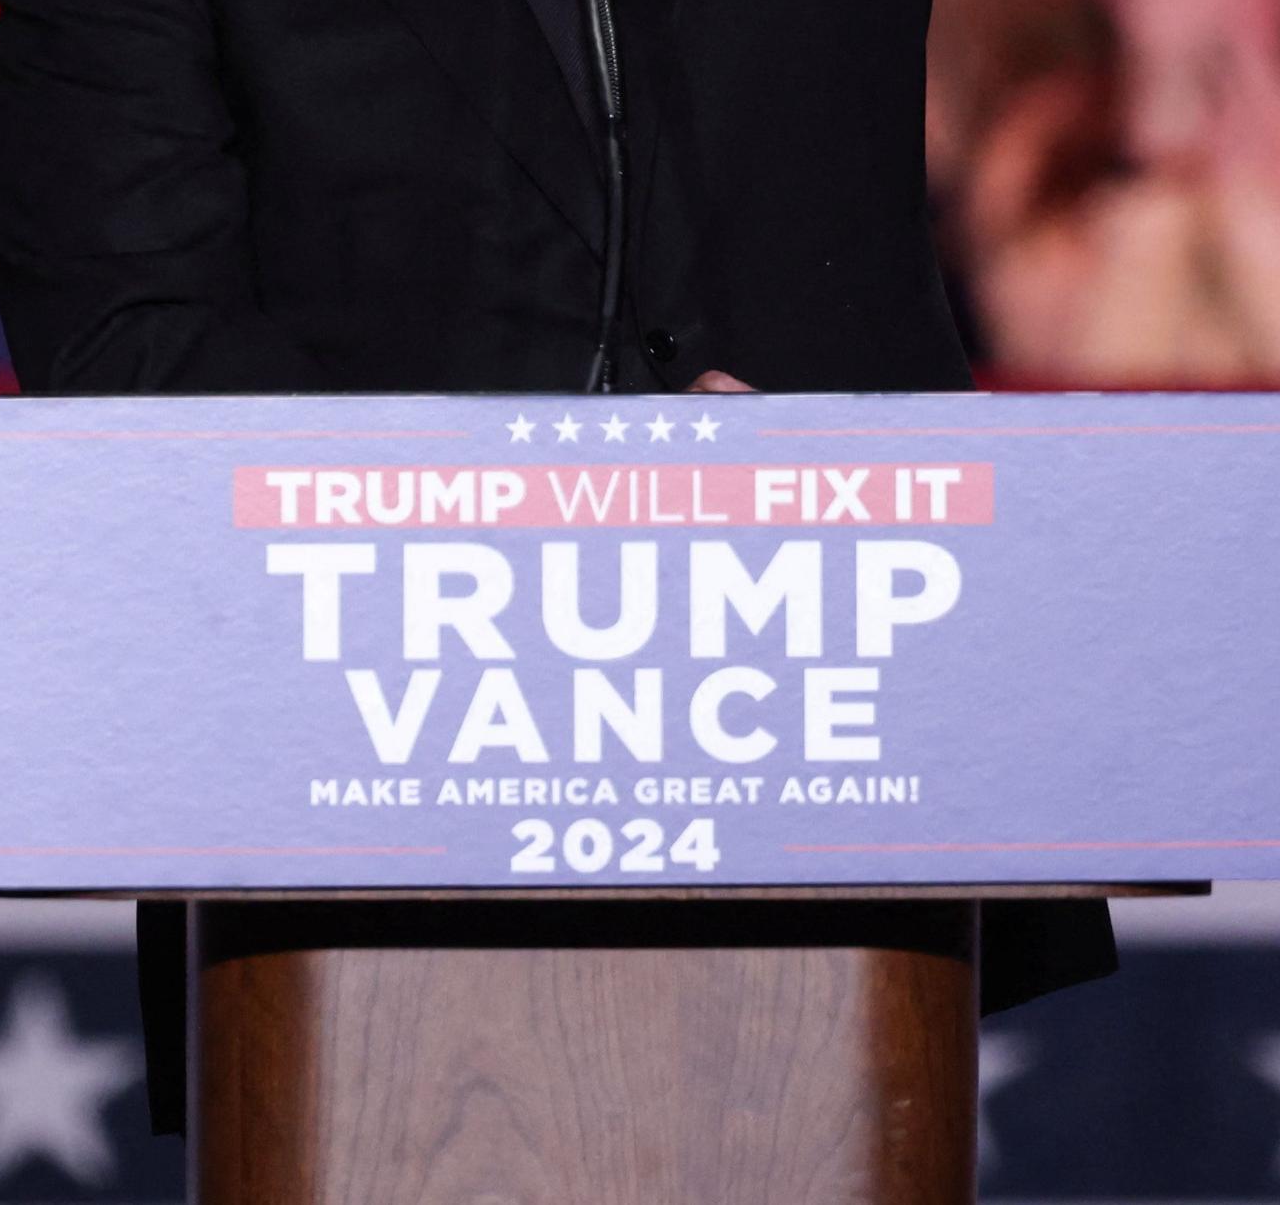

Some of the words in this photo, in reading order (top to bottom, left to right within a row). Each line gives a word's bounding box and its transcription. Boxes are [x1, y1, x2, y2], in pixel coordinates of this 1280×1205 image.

[265, 469, 527, 525] TRUMP
[546, 470, 729, 523] WILL
[755, 468, 871, 523] FIX
[896, 468, 962, 522] IT
[266, 540, 961, 661] TRUMP
[345, 667, 881, 764] VANCE
[311, 778, 421, 806] MAKE
[437, 777, 618, 805] AMERICA
[634, 777, 764, 804] GREAT
[780, 776, 919, 804] AGAIN!
[511, 819, 719, 872] 2024
